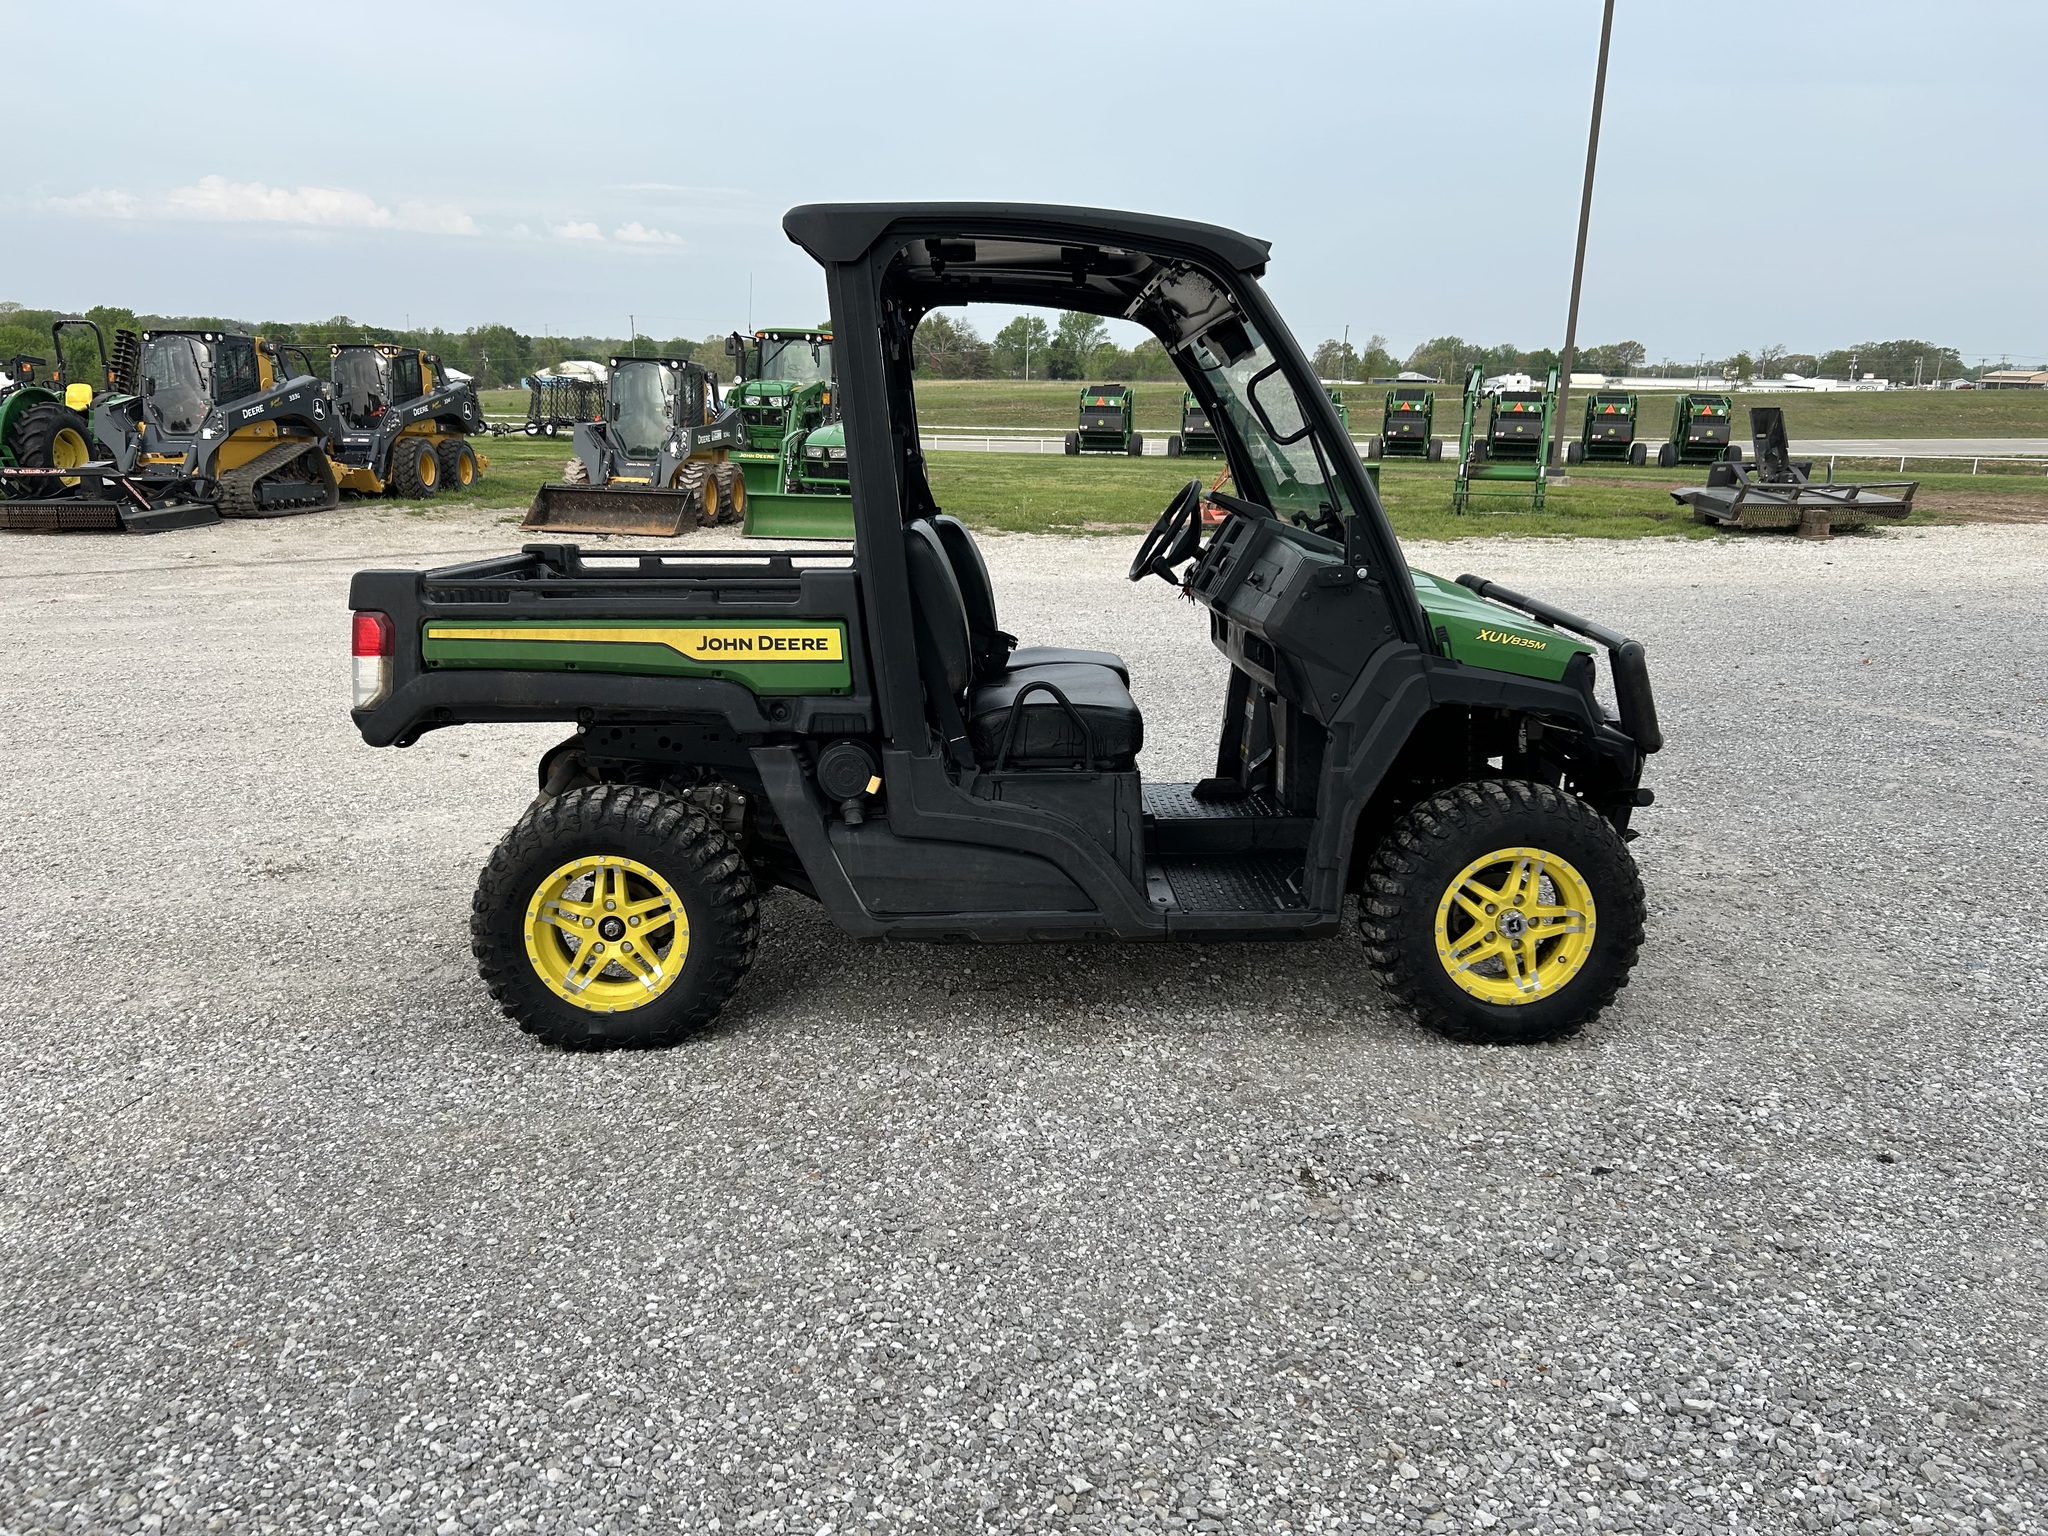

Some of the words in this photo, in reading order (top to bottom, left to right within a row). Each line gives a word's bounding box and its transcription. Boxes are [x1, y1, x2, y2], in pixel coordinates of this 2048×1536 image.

[242, 404, 265, 419] DEERE
[412, 404, 429, 417] DEERE
[697, 434, 711, 445] DEERE
[696, 635, 753, 651] JOHN
[758, 635, 829, 651] DEERE
[1475, 628, 1547, 651] XUV835M
